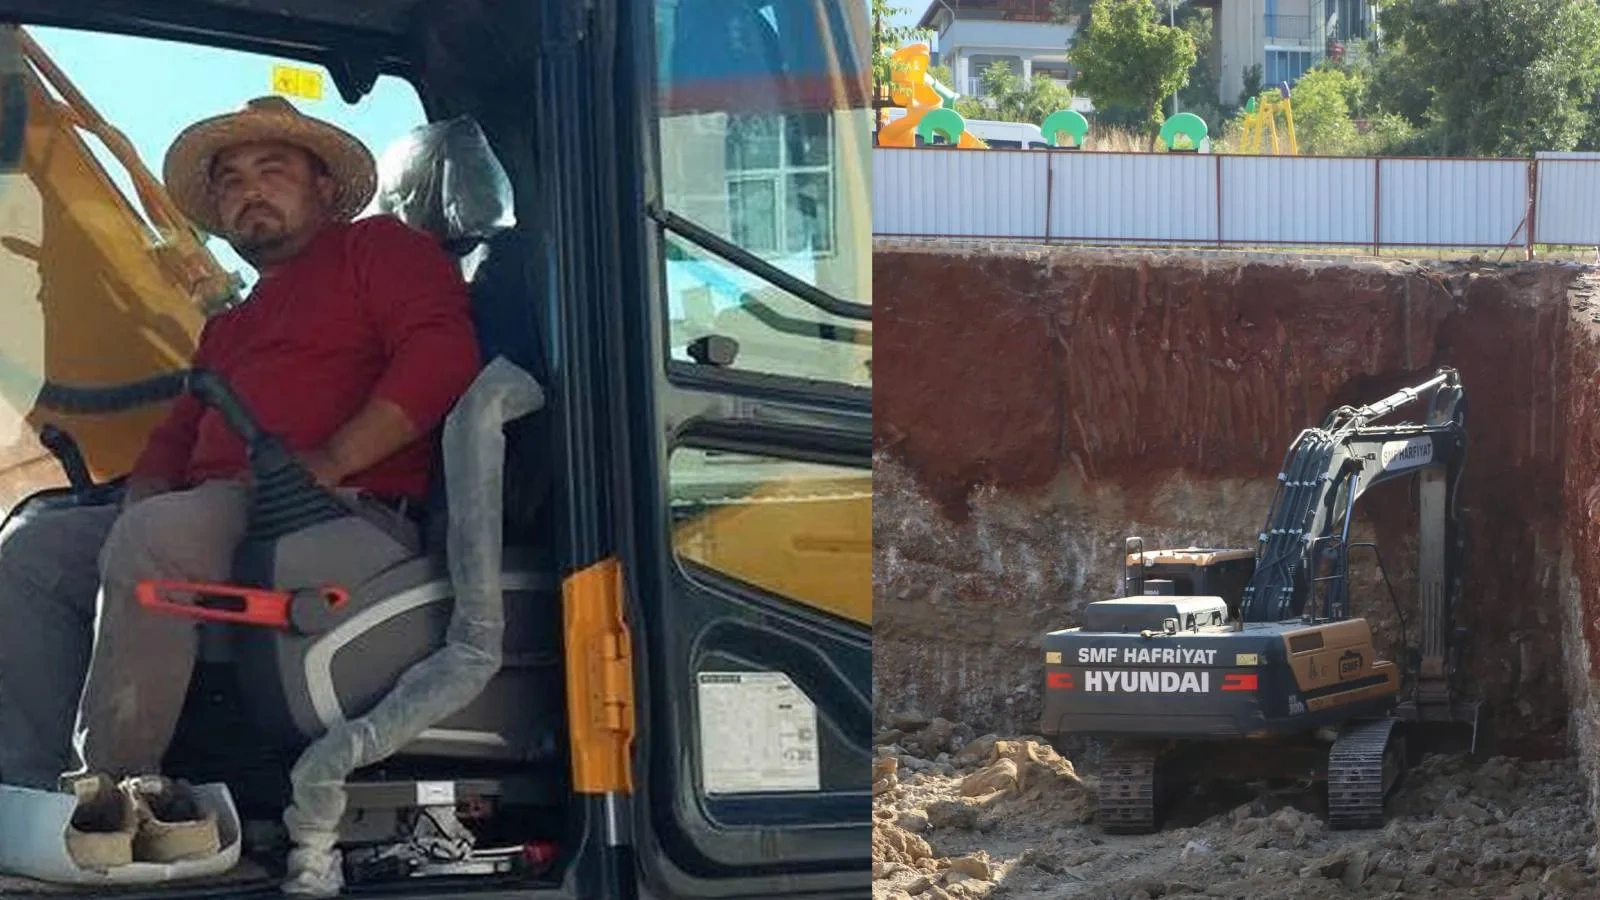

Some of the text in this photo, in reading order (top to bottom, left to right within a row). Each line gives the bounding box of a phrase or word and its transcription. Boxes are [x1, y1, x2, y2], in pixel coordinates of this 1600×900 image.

[1078, 644, 1217, 665] SMF HAFRİYAT
[1085, 670, 1210, 693] HYUNDAI
